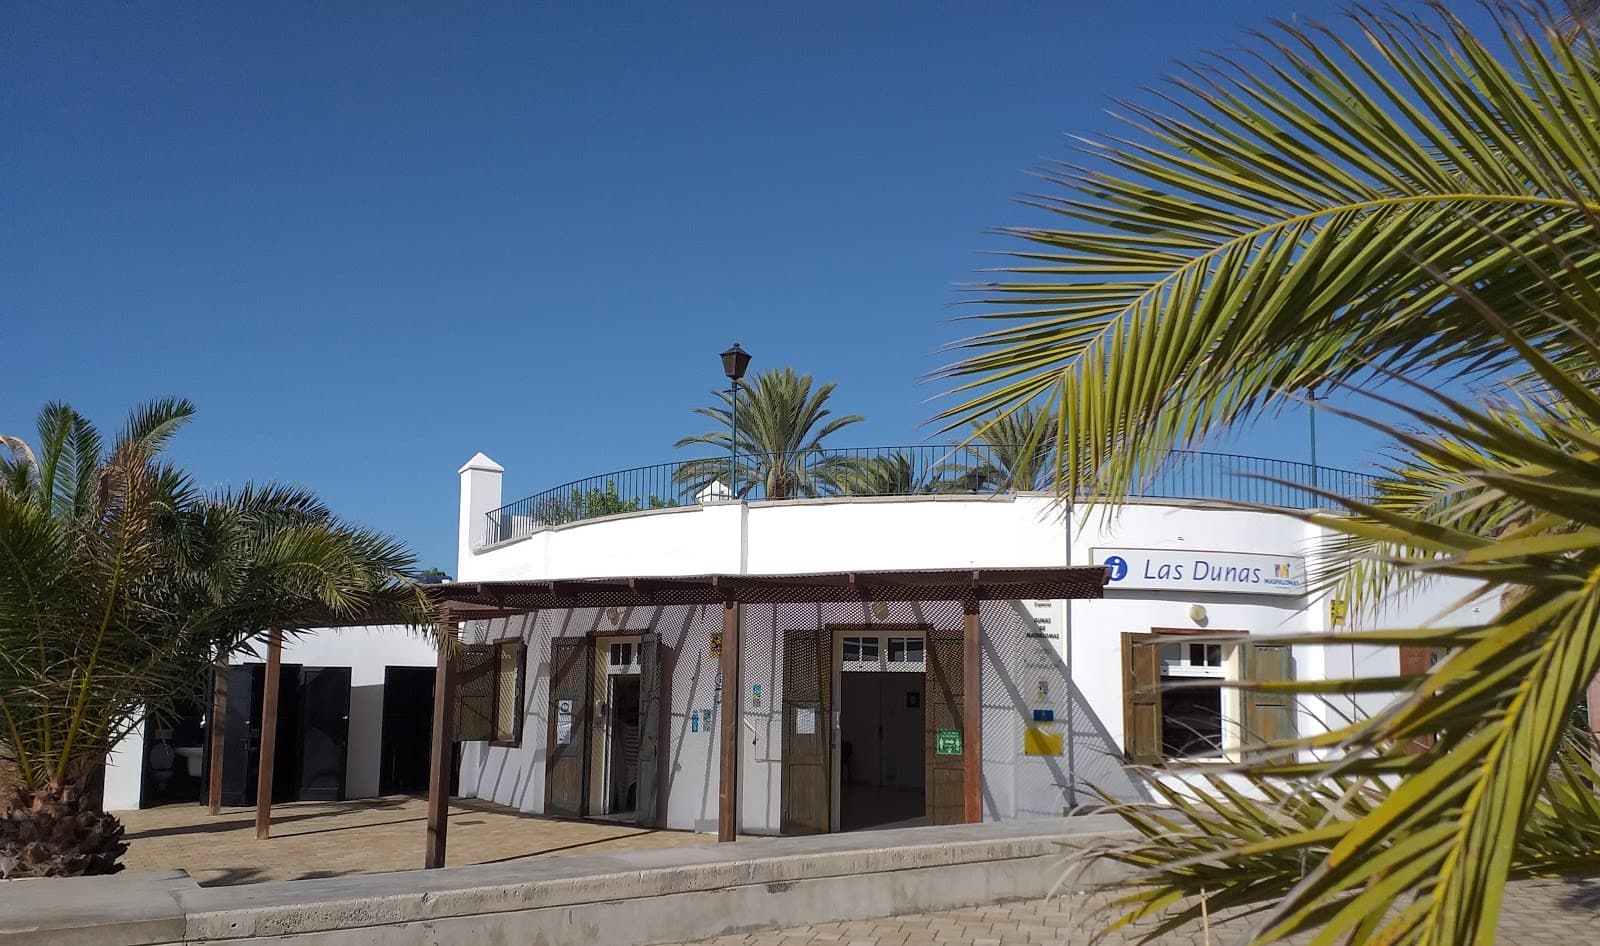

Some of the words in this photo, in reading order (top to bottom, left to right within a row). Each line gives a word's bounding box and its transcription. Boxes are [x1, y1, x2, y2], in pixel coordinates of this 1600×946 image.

[1144, 559, 1184, 580] Las
[1193, 560, 1261, 583] Dunas
[1264, 578, 1299, 587] MASPALOMAS
